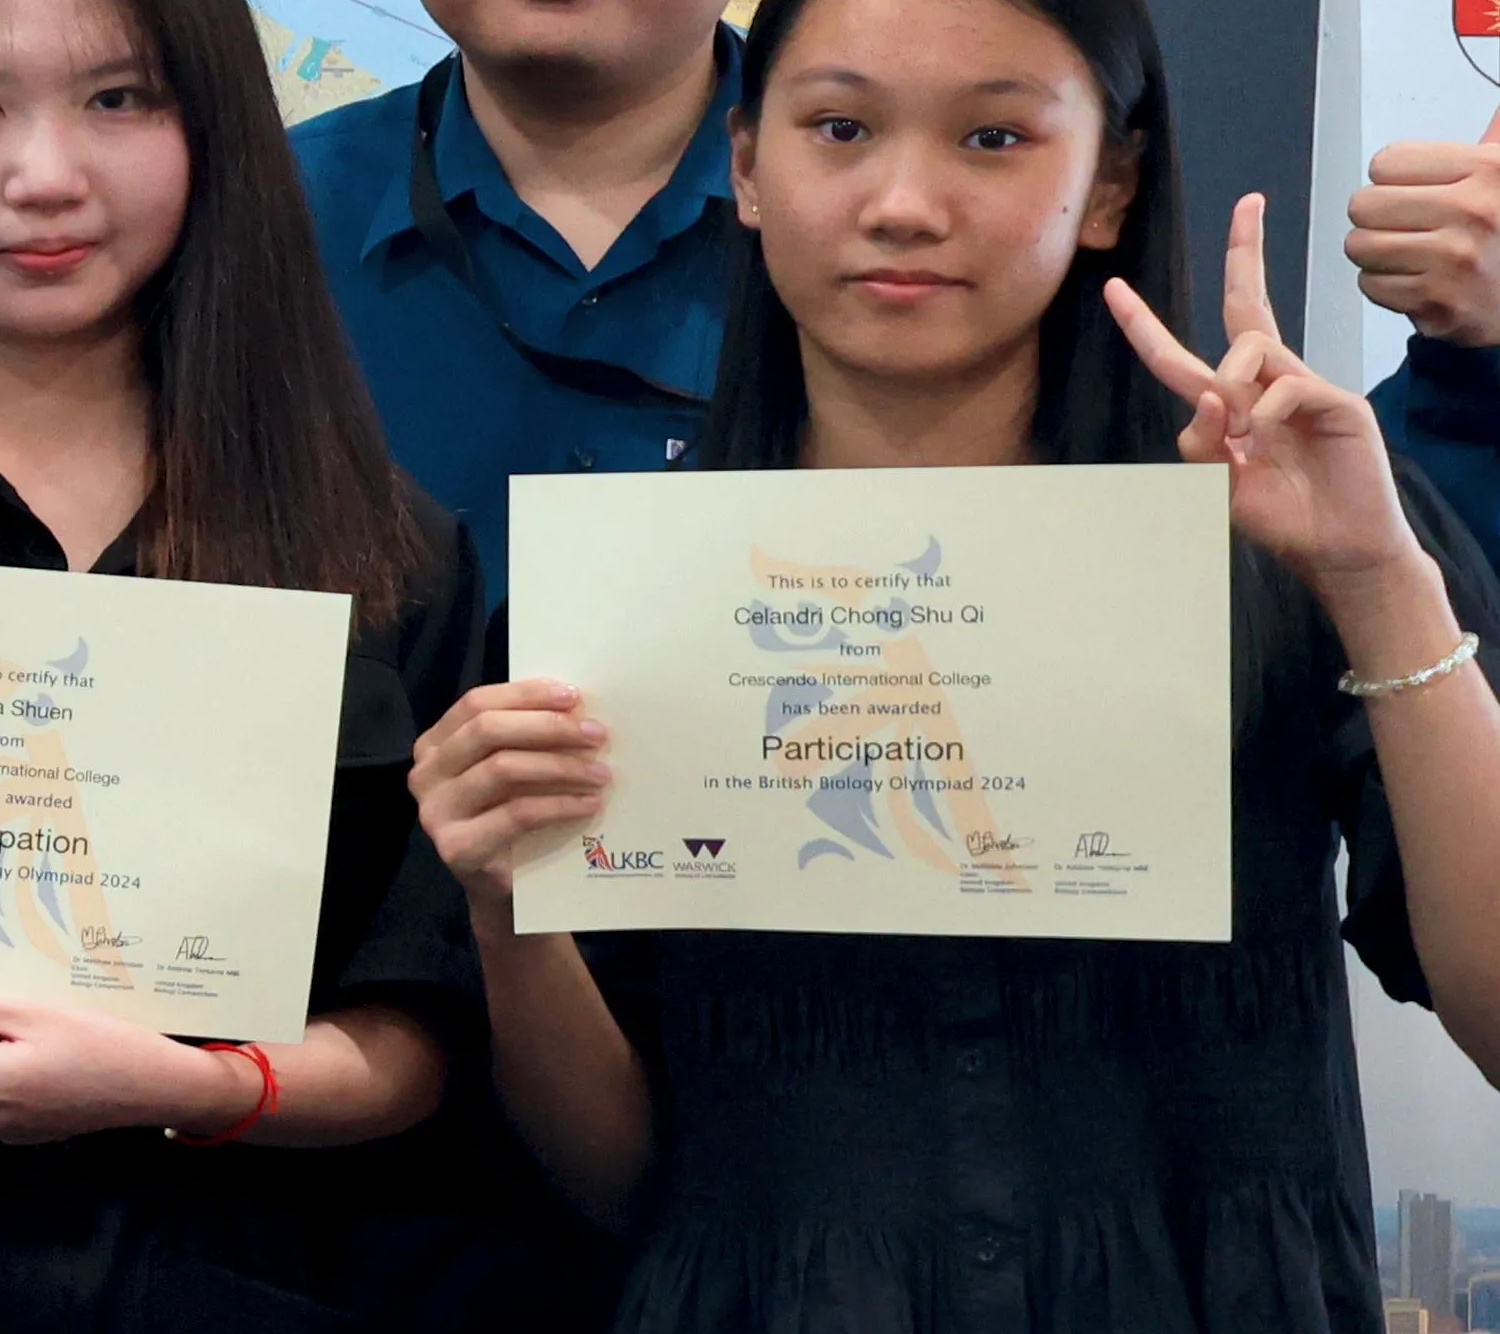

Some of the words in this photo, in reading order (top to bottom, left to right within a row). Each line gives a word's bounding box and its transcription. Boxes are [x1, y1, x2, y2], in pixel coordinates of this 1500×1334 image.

[733, 606, 823, 626] Celandri
[830, 606, 903, 629] Chong
[910, 605, 953, 624] Shu
[960, 605, 984, 624] Qi
[10, 699, 73, 721] Shuen
[762, 735, 964, 768] Participation
[672, 861, 736, 876] WARWICK
